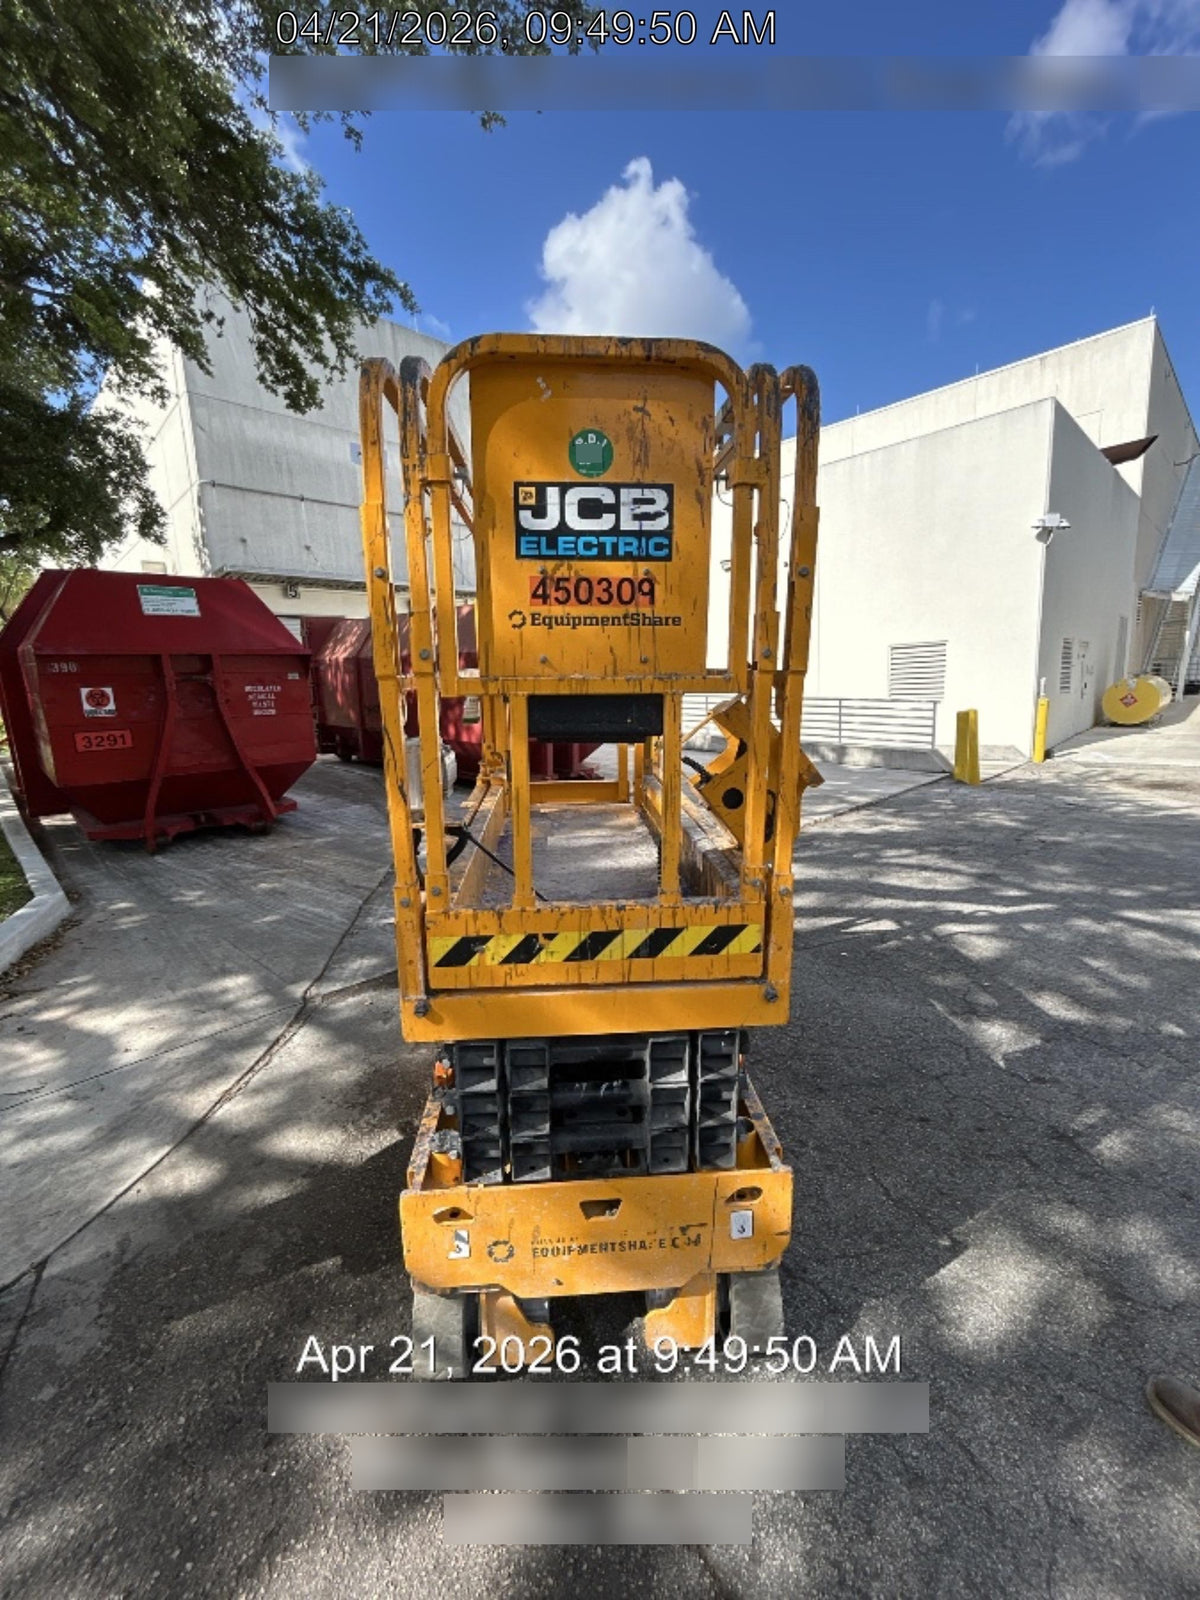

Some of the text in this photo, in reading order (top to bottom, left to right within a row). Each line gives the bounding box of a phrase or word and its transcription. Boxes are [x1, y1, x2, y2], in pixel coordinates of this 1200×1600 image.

[518, 486, 670, 531] JCB
[520, 536, 669, 557] ELECTRIC
[531, 576, 655, 606] 450309
[530, 612, 682, 630] EquipmentShare
[81, 733, 127, 749] 3291
